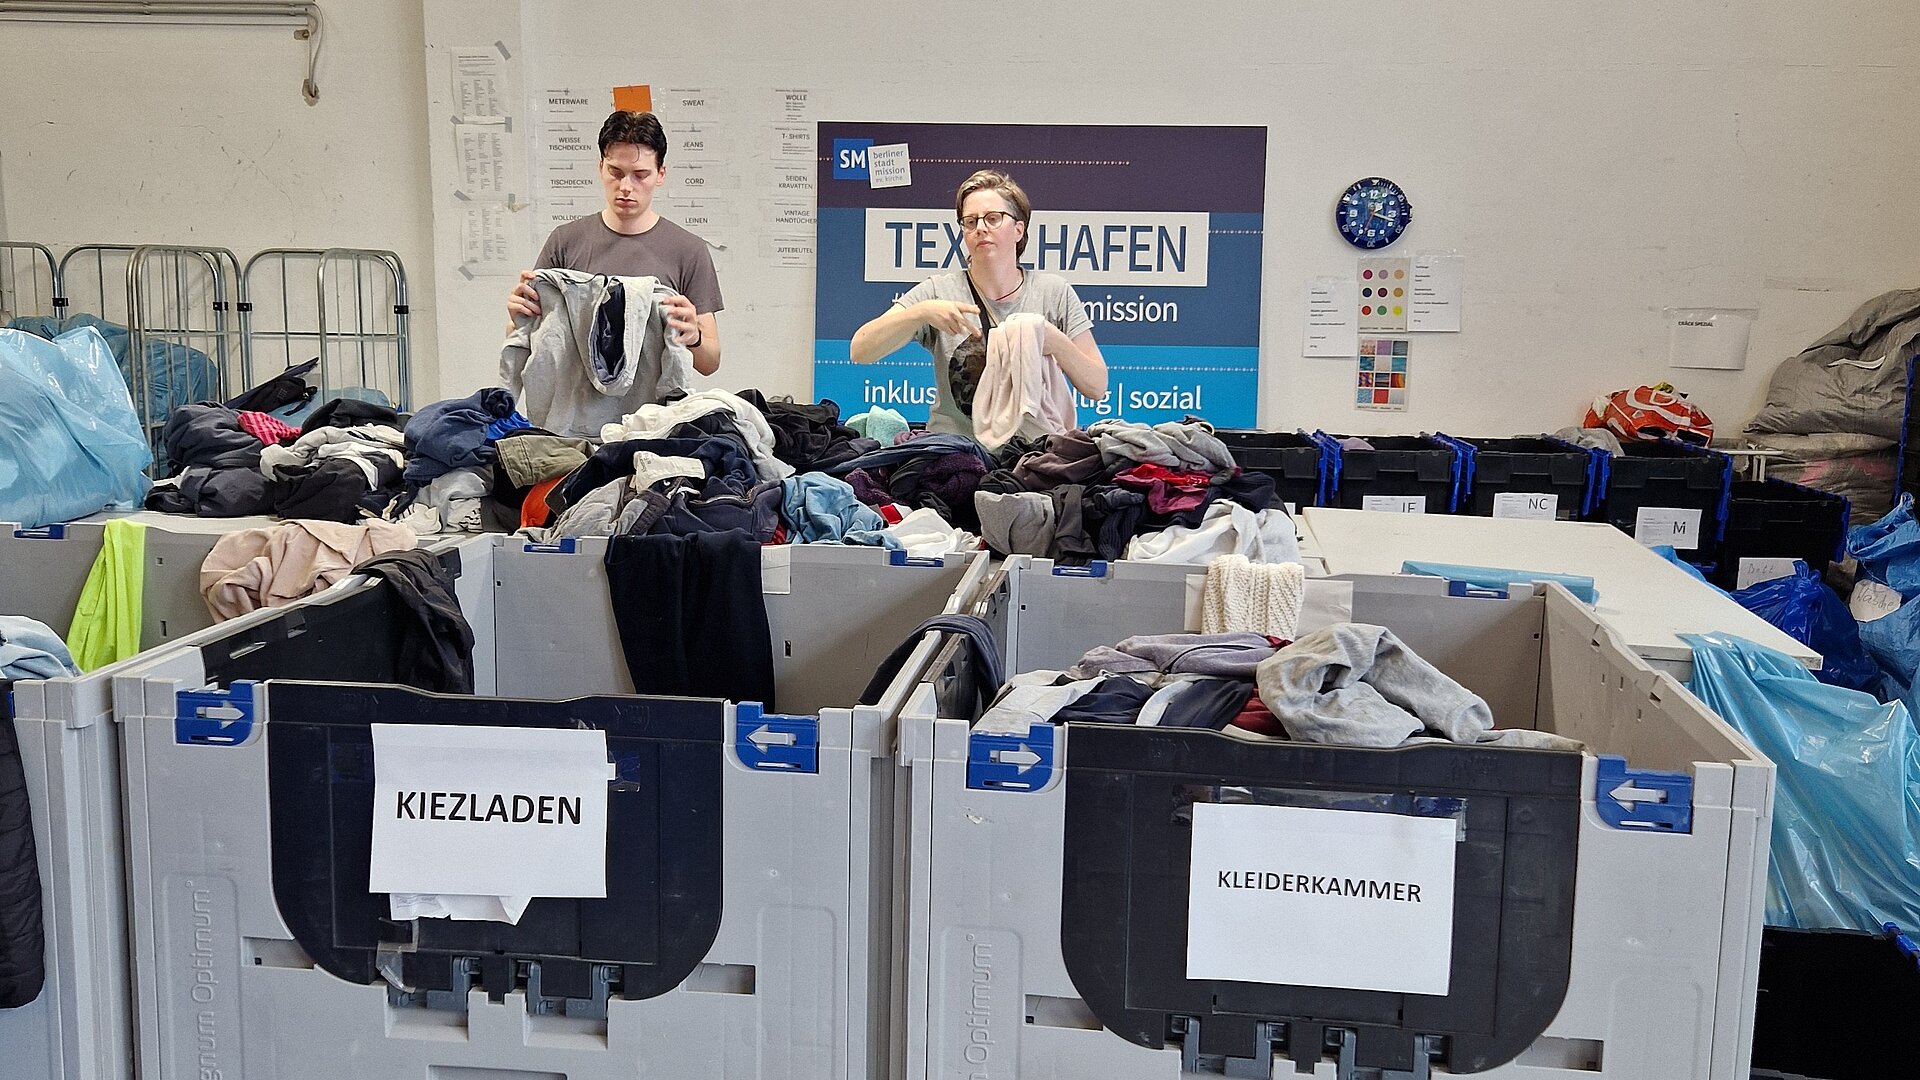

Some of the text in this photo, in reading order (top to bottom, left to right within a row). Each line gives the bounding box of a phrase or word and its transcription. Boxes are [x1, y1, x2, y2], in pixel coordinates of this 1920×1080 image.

[548, 98, 589, 106] METERWARE
[682, 99, 705, 107] SWEAT
[789, 133, 810, 141] SHIRTS
[682, 141, 704, 149] JEANS
[839, 149, 866, 169] SM
[873, 150, 904, 159] berliner
[874, 159, 895, 168] stadt
[875, 166, 906, 176] mission
[785, 175, 808, 183] SEIDEN
[1369, 190, 1379, 199] 12
[551, 214, 584, 222] WOLLDEC
[685, 217, 708, 225] LEINEN
[777, 246, 814, 254] JUTEBEUTEL
[1081, 294, 1178, 323] mission
[863, 379, 939, 405] inklus
[1129, 384, 1202, 410] sozial
[1528, 498, 1548, 510] NC
[1672, 520, 1687, 534] M
[395, 791, 583, 826] KIEZLADEN
[1216, 869, 1423, 905] KLEIDERKAMMER
